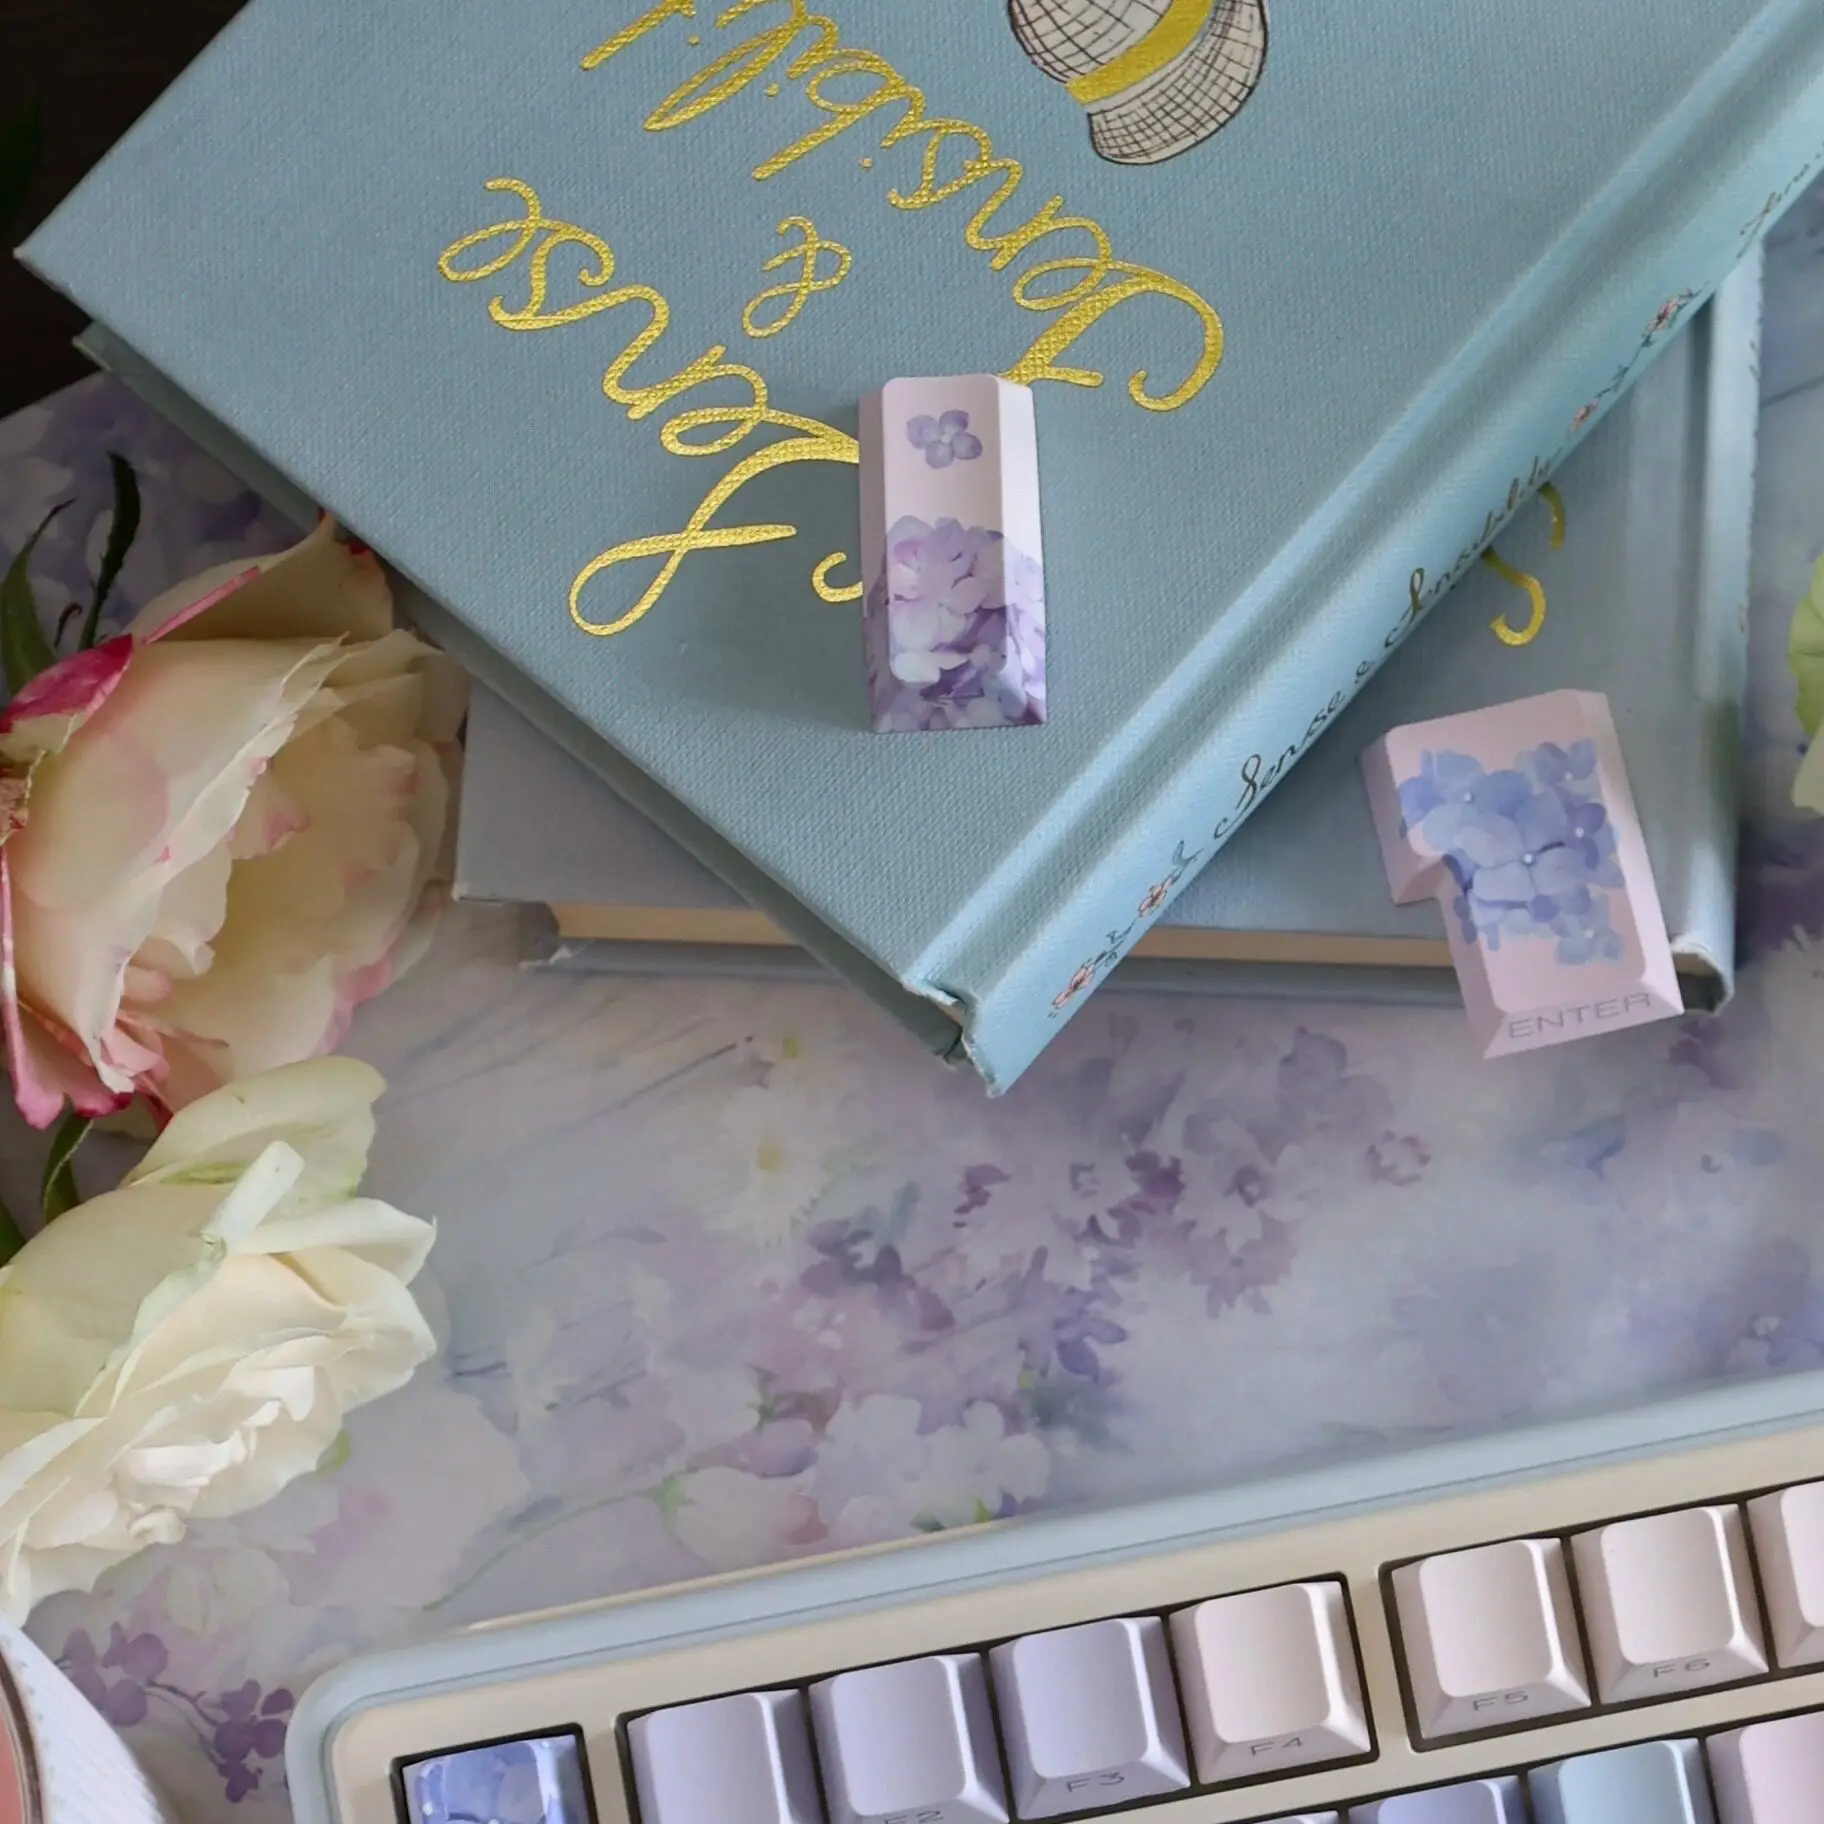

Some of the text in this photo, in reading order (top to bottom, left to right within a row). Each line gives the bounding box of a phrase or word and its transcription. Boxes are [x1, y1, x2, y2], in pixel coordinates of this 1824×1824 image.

[741, 214, 853, 338] &
[1213, 690, 1347, 840] Sense
[1509, 991, 1652, 1039] ENTER
[1652, 1657, 1711, 1679] F6
[1470, 1689, 1529, 1711] F5
[1249, 1736, 1304, 1758] F4
[1065, 1771, 1126, 1794] F3
